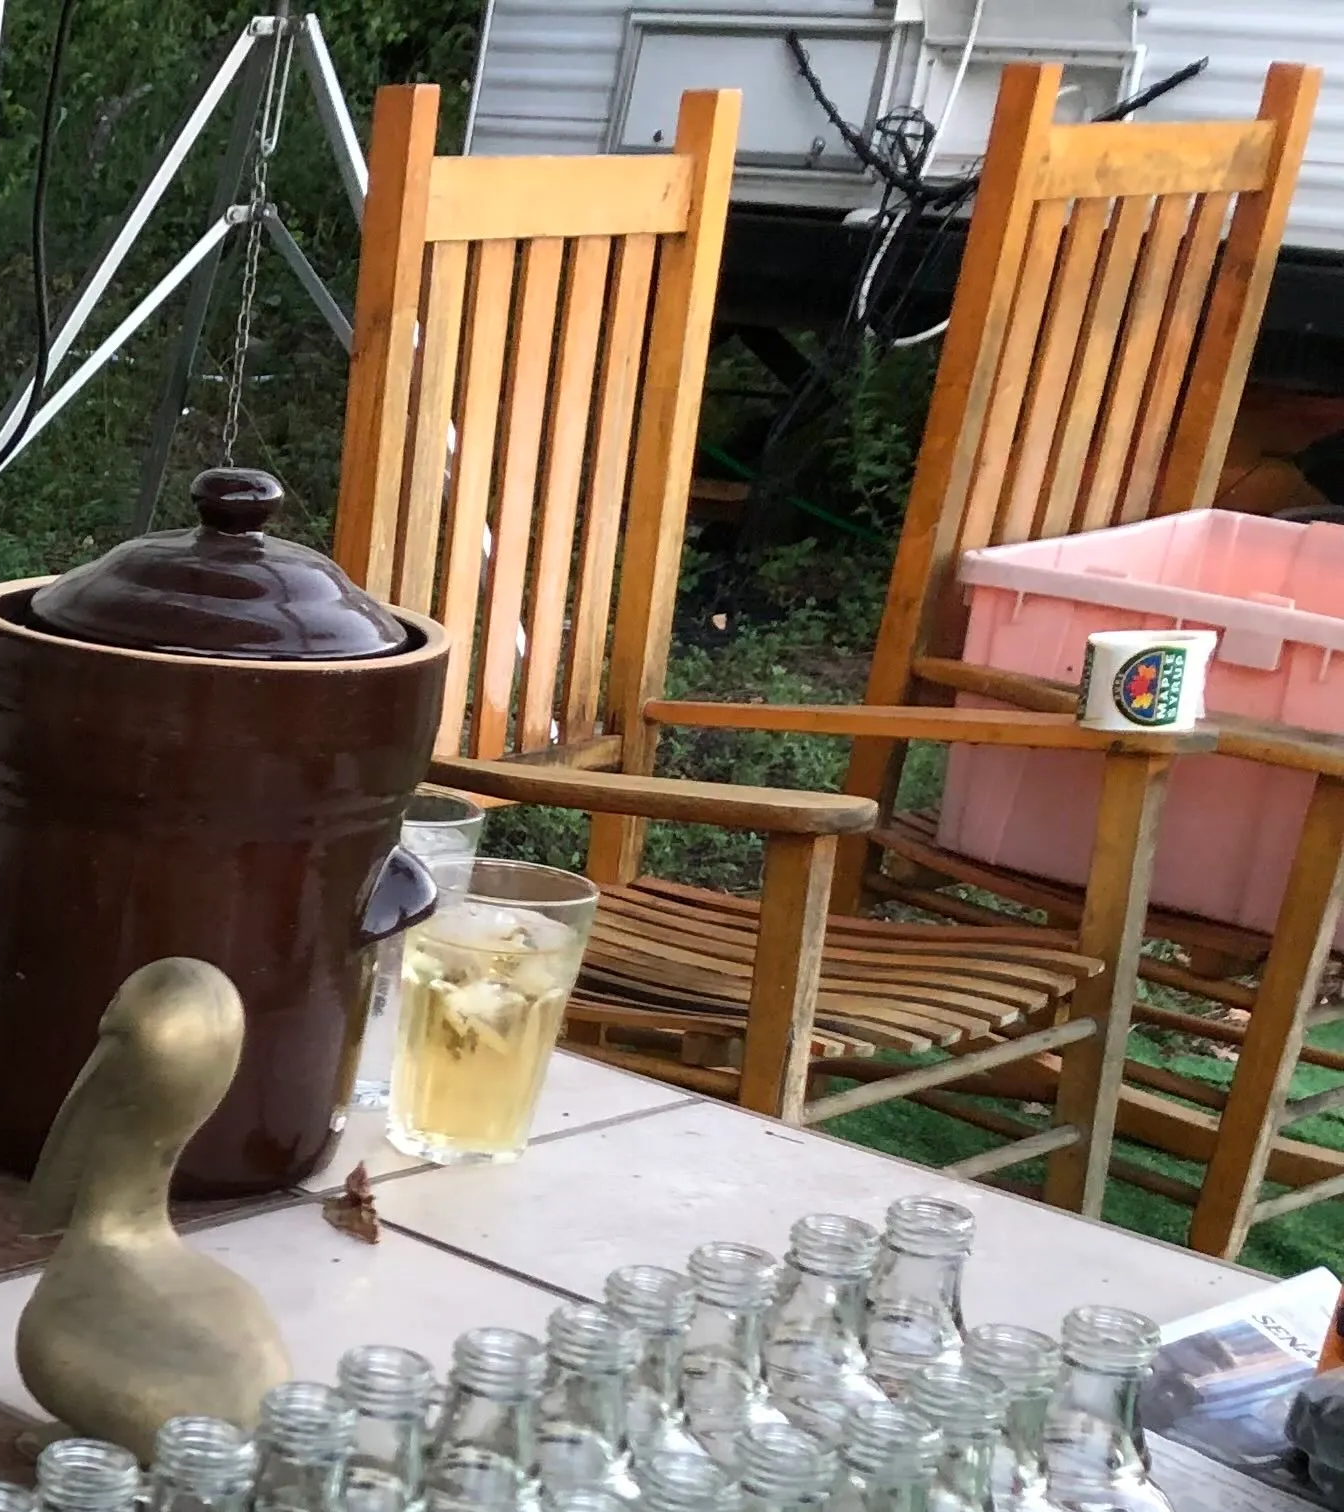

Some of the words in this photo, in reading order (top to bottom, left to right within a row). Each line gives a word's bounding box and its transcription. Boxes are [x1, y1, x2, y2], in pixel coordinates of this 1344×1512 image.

[1155, 654, 1176, 719] MAPLE
[1167, 655, 1184, 718] SYRUP
[1248, 1313, 1318, 1362] SENA
